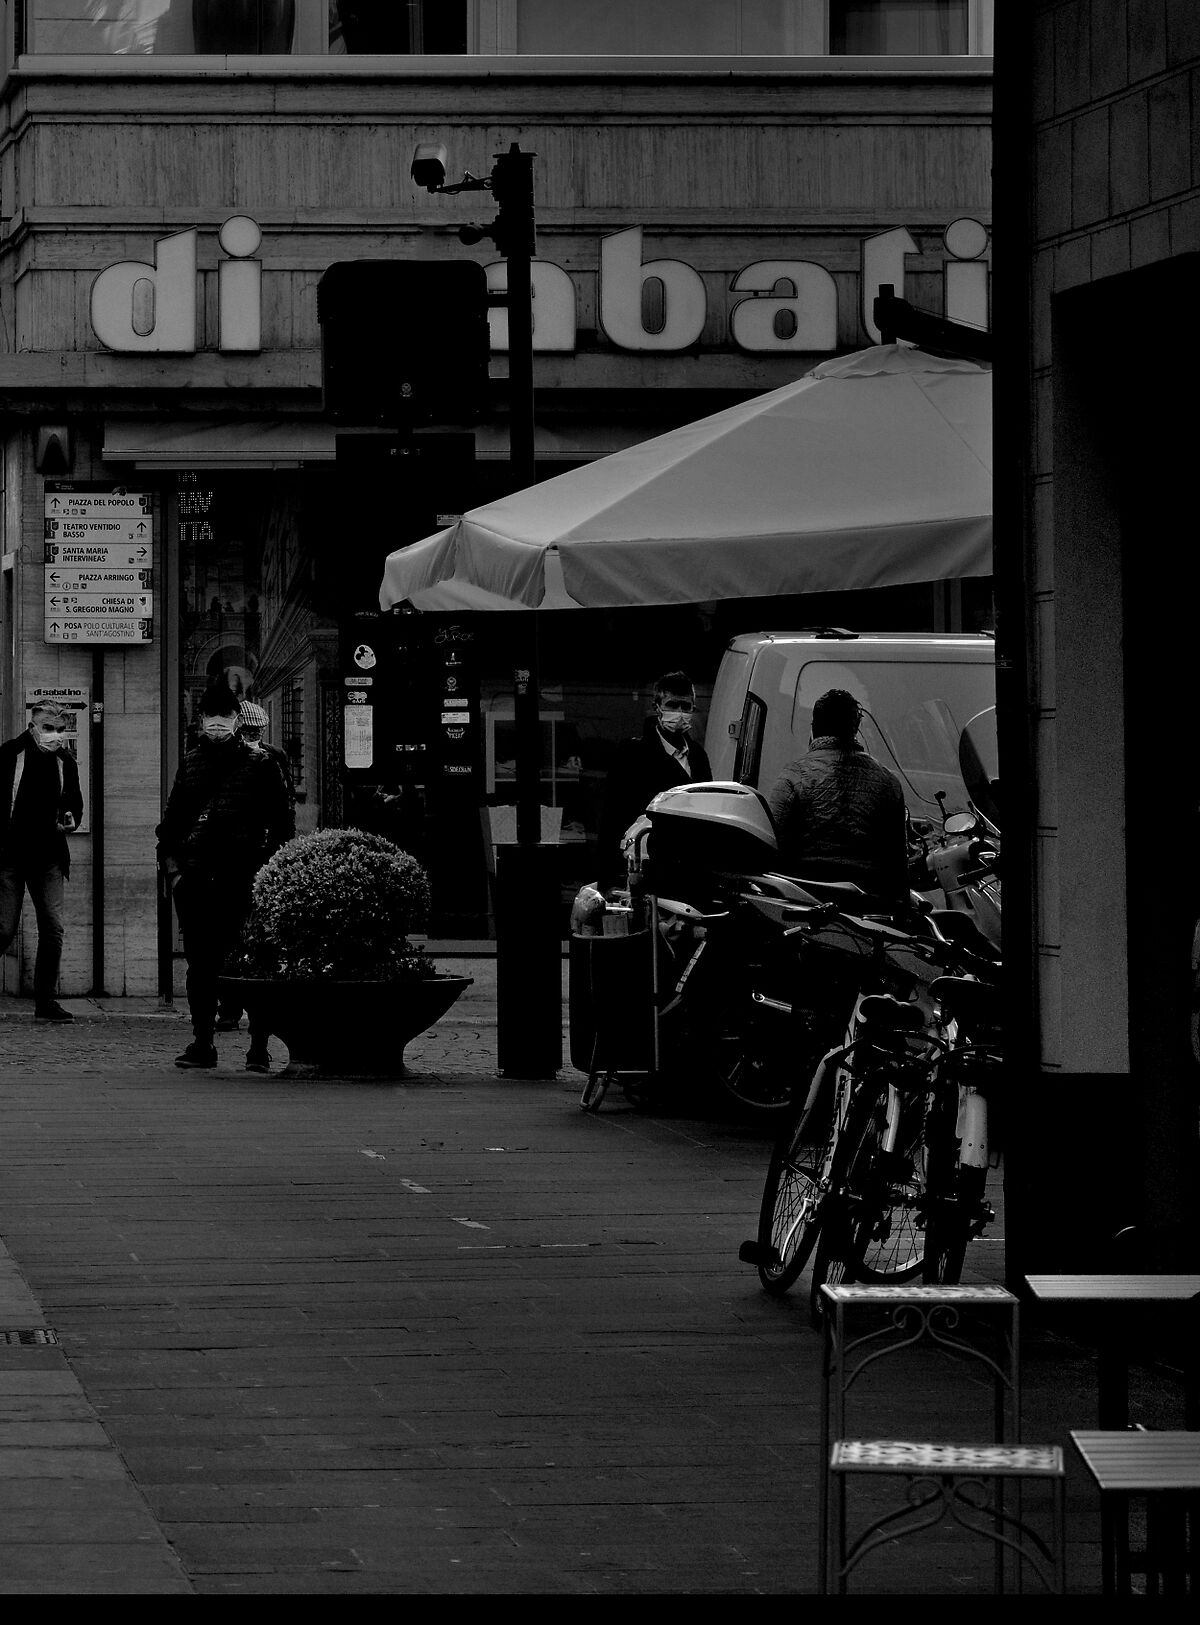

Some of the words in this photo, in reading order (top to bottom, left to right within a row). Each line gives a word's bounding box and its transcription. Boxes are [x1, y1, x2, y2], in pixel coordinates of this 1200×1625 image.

[89, 214, 262, 353] di
[63, 523, 88, 531] TEATRO
[89, 523, 121, 531] VENTIDIO
[62, 547, 84, 555] SANTA
[86, 547, 109, 555] MARIA
[64, 622, 83, 630] POSA
[83, 622, 100, 630] POLO
[101, 622, 135, 630] CULTURALE
